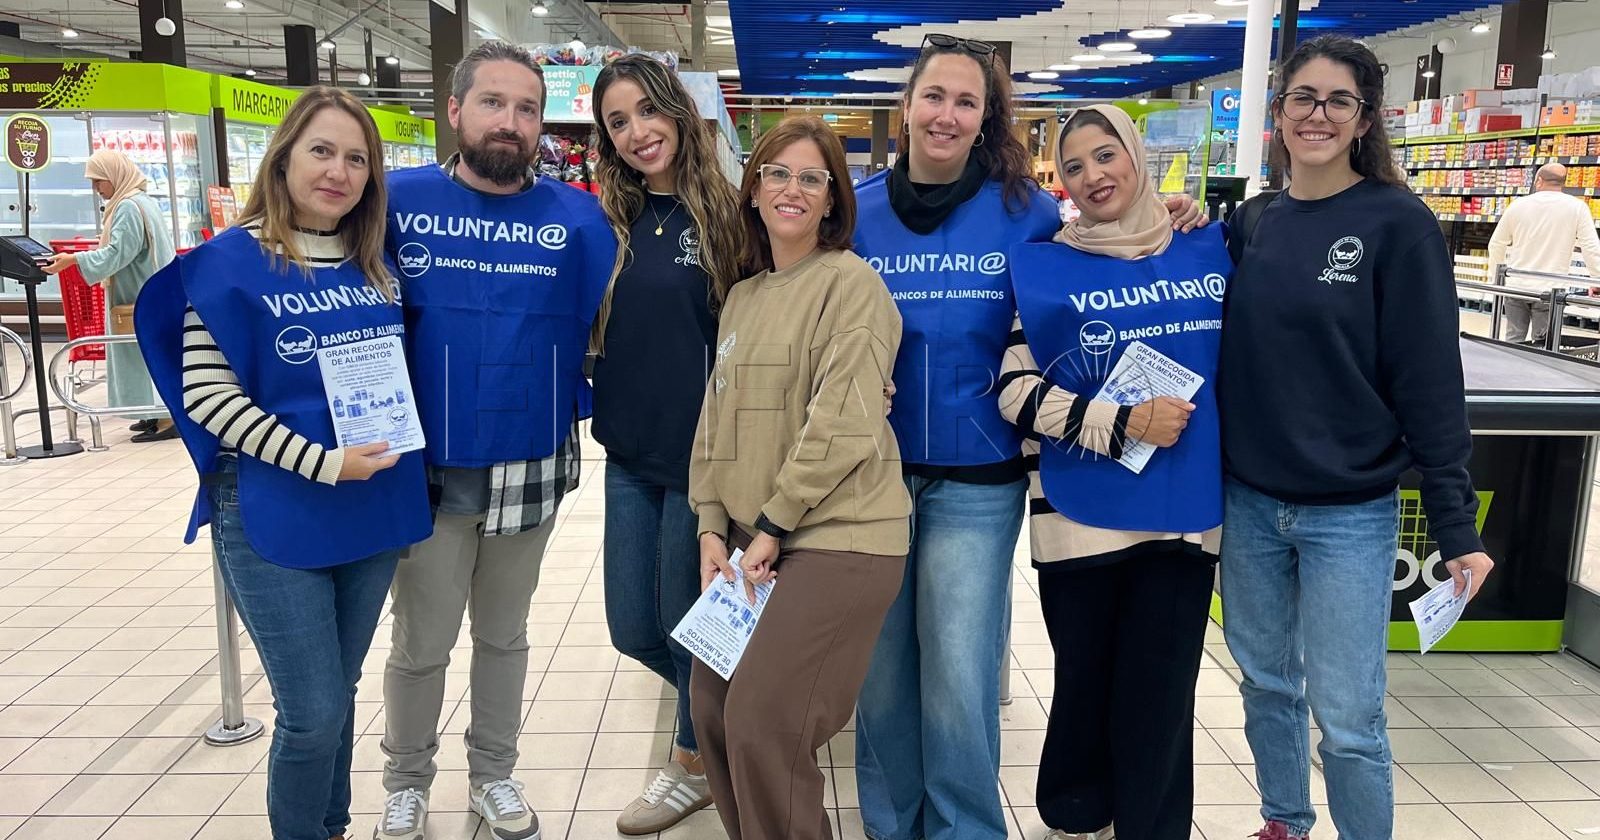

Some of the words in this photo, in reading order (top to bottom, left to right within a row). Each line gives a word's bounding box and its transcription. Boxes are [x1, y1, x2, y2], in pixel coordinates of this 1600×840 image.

[12, 81, 52, 93] precios
[396, 212, 567, 250] VOLUNTARI@
[435, 257, 477, 270] BANCO
[479, 261, 492, 273] DE
[495, 263, 557, 277] ALIMENTOS
[865, 251, 1006, 275] OLUNTARI@
[1317, 268, 1359, 285] Lorena
[890, 291, 927, 300] ANCOS
[930, 290, 943, 299] DE
[946, 289, 1004, 300] ALIMENTOS
[1069, 273, 1226, 313] VOLUNTARI@
[321, 330, 361, 346] BANCO
[362, 327, 375, 339] DE
[1119, 325, 1163, 341] BANCO
[1165, 322, 1180, 335] DE
[325, 347, 350, 358] GRAN
[351, 341, 395, 354] RECOGIDA
[331, 358, 343, 366] DE
[345, 350, 392, 363] ALIMENTOS
[1135, 353, 1146, 363] DE
[1146, 359, 1188, 388] ALIMENTOS
[1136, 345, 1158, 361] GRAN
[1158, 356, 1195, 384] RECOGIDA
[678, 632, 712, 661] RECOGIDA
[686, 627, 723, 659] ALIMENTOS
[711, 658, 729, 675] GRAN
[720, 654, 731, 665] DE
